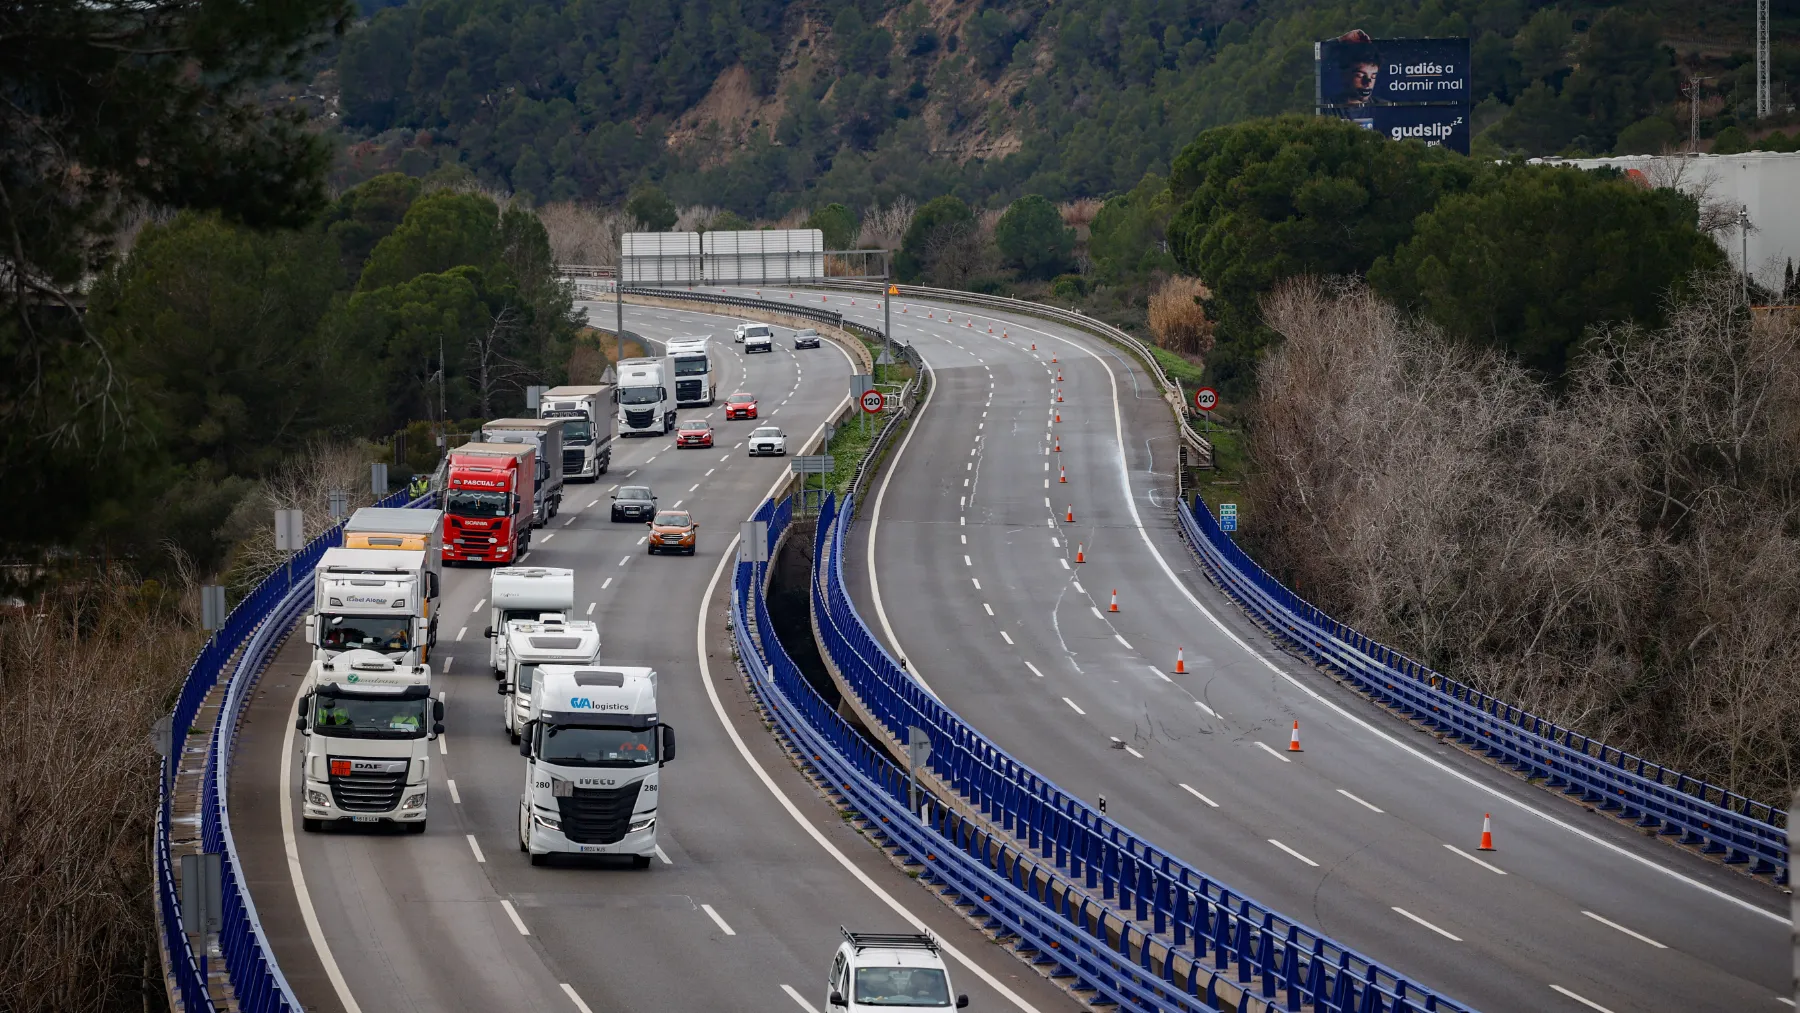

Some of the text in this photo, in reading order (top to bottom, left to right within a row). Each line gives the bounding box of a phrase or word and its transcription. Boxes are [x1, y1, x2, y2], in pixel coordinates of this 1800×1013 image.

[1389, 62, 1454, 75] Di adiós a
[1389, 78, 1463, 91] dormir mal
[864, 397, 880, 406] 120
[1199, 394, 1215, 403] 120
[463, 479, 495, 487] PASCUAL
[592, 700, 629, 711] logistics
[536, 781, 550, 789] 280
[579, 778, 616, 786] IVECO
[644, 784, 658, 792] 280
